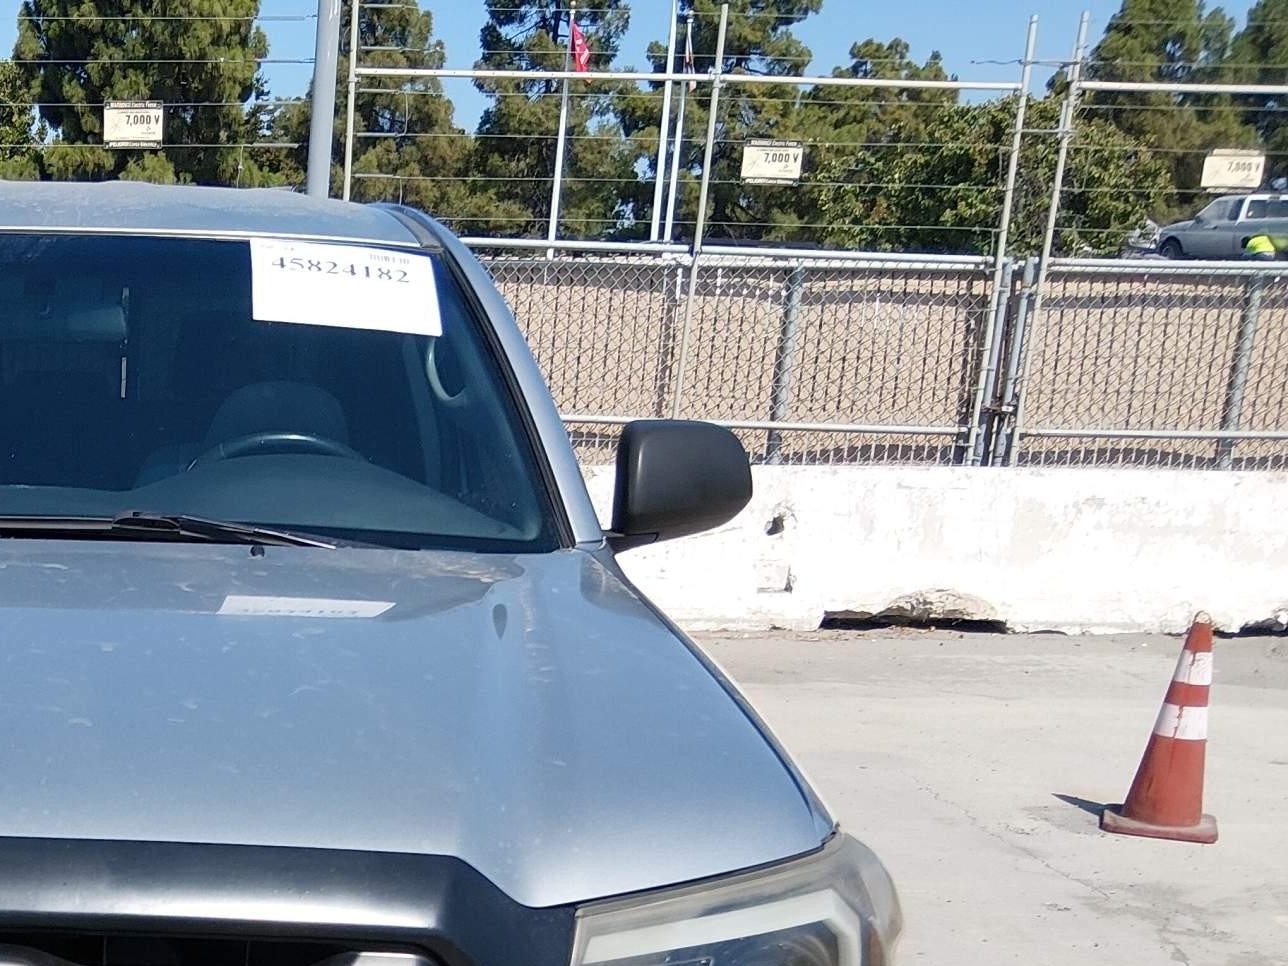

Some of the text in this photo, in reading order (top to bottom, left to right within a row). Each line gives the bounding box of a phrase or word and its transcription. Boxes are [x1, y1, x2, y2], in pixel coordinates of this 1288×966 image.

[125, 115, 160, 126] 7,000 V
[764, 153, 800, 164] 7,000 V
[271, 257, 410, 283] 45824182
